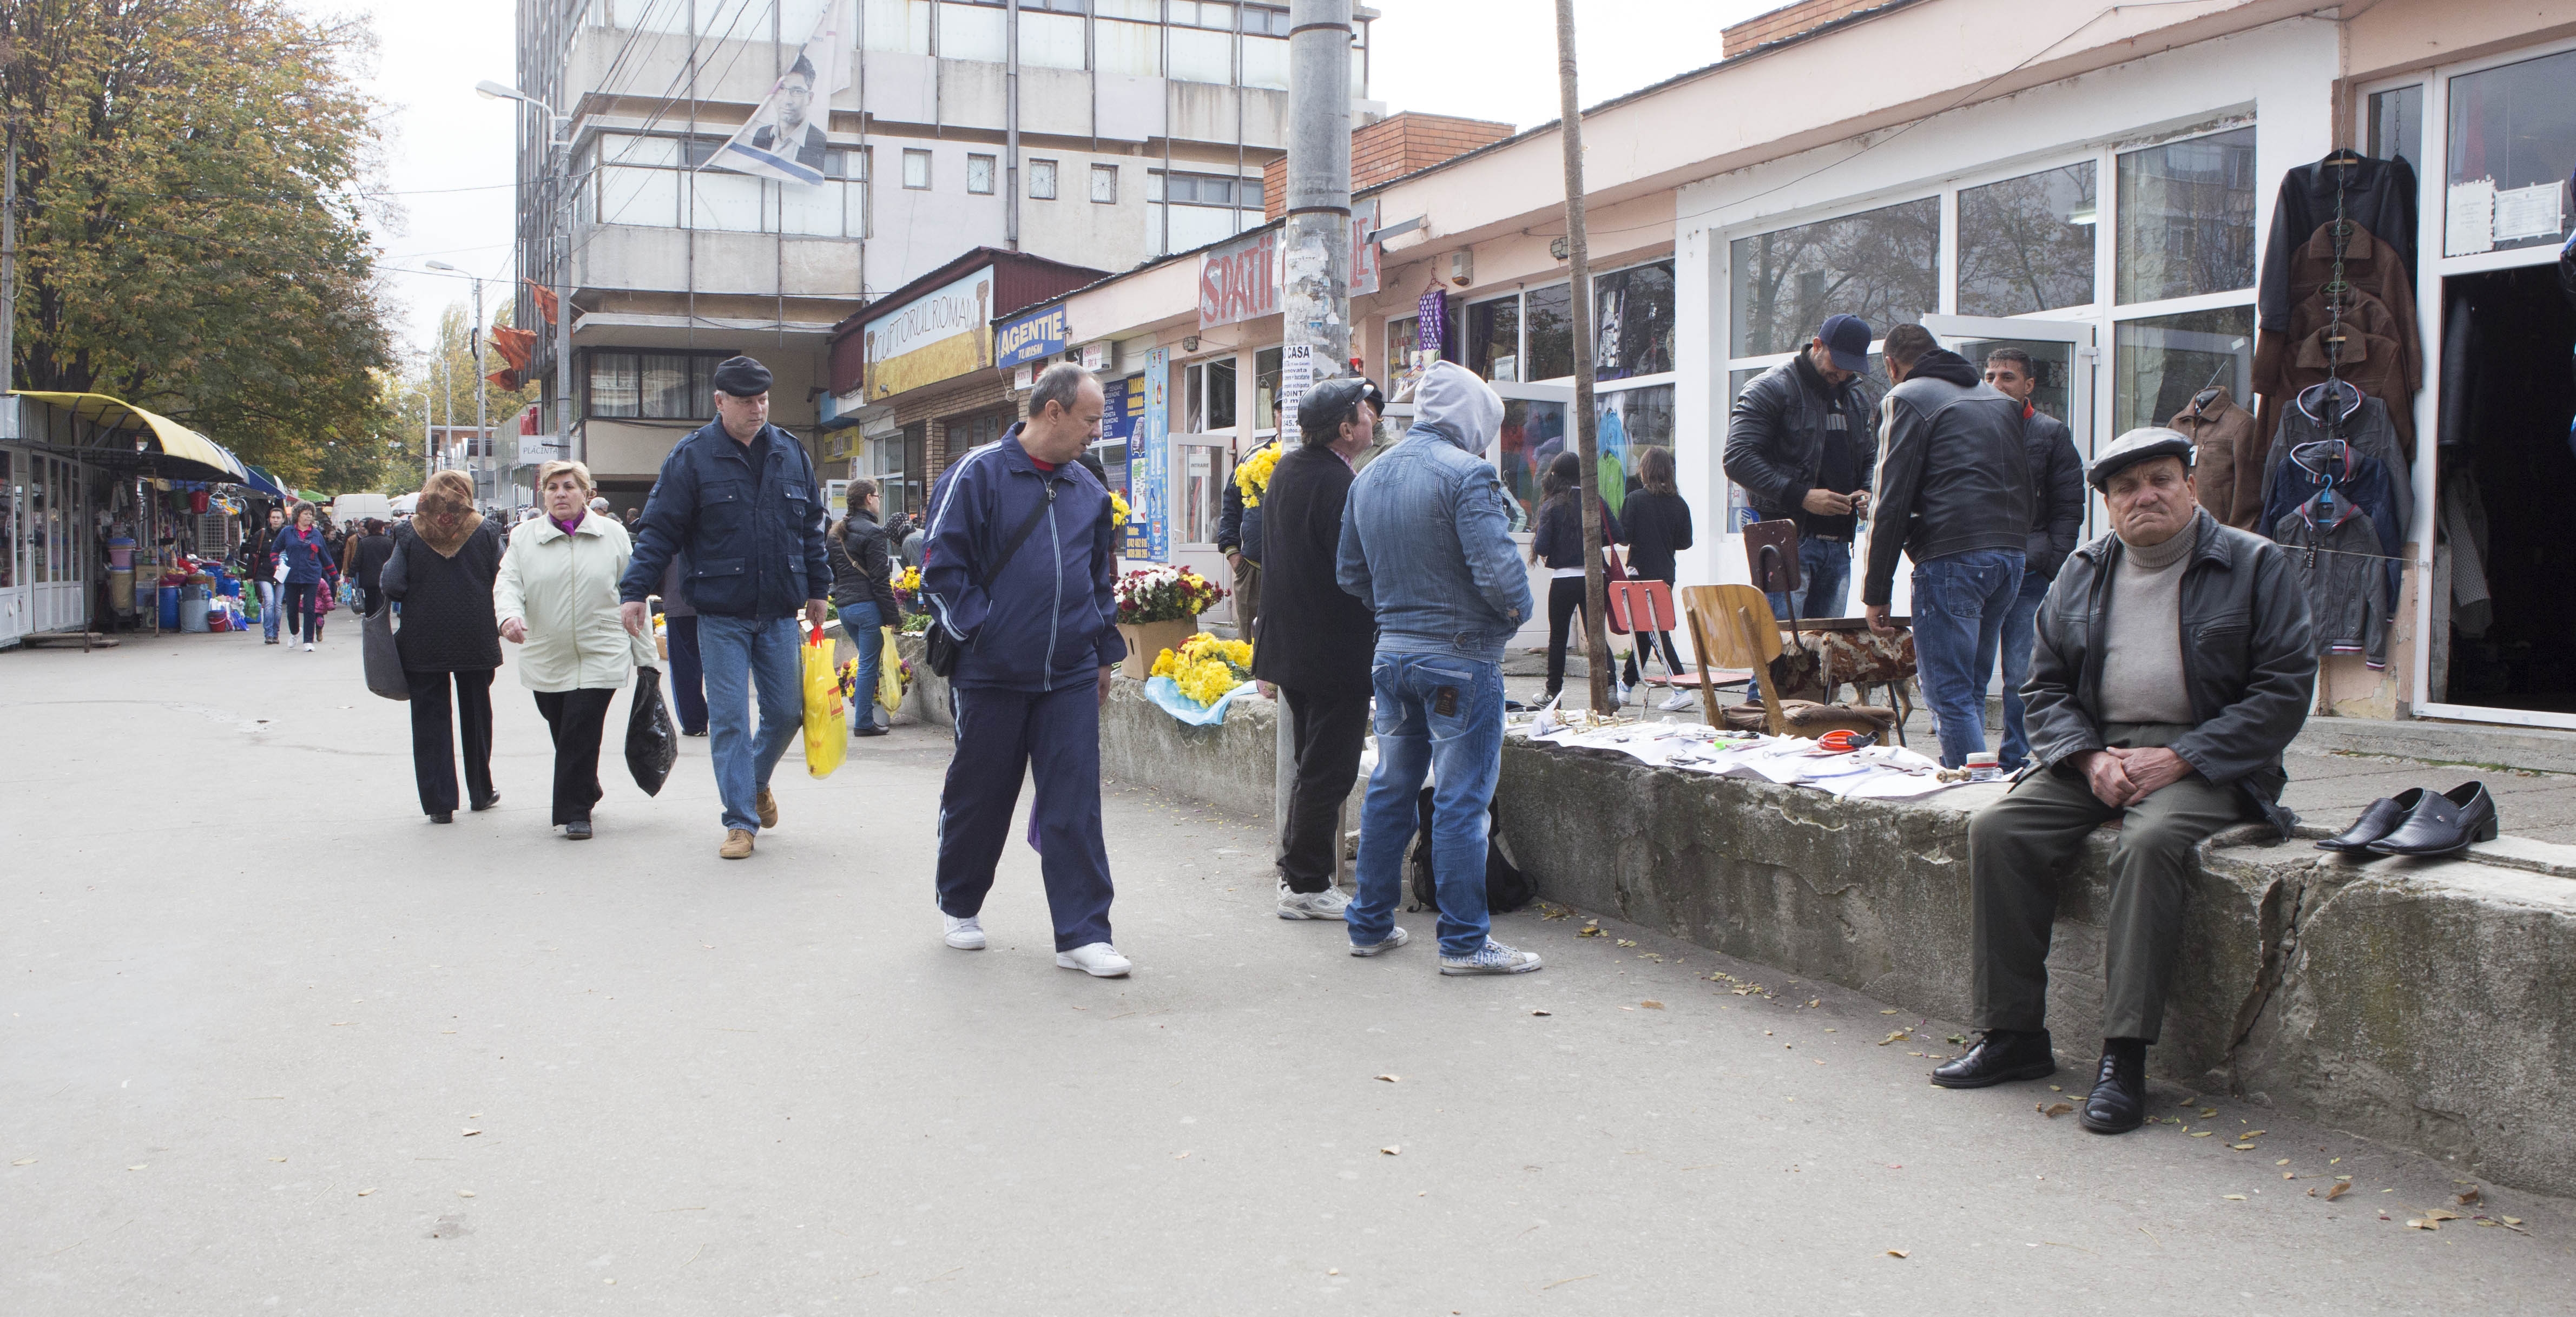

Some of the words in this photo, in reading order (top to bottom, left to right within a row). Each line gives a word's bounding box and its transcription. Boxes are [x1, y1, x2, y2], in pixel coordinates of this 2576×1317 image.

[875, 302, 931, 365] CUPTORUL
[1000, 311, 1063, 359] AGENTIE
[1018, 343, 1043, 360] TURISM
[1288, 346, 1310, 359] CASA
